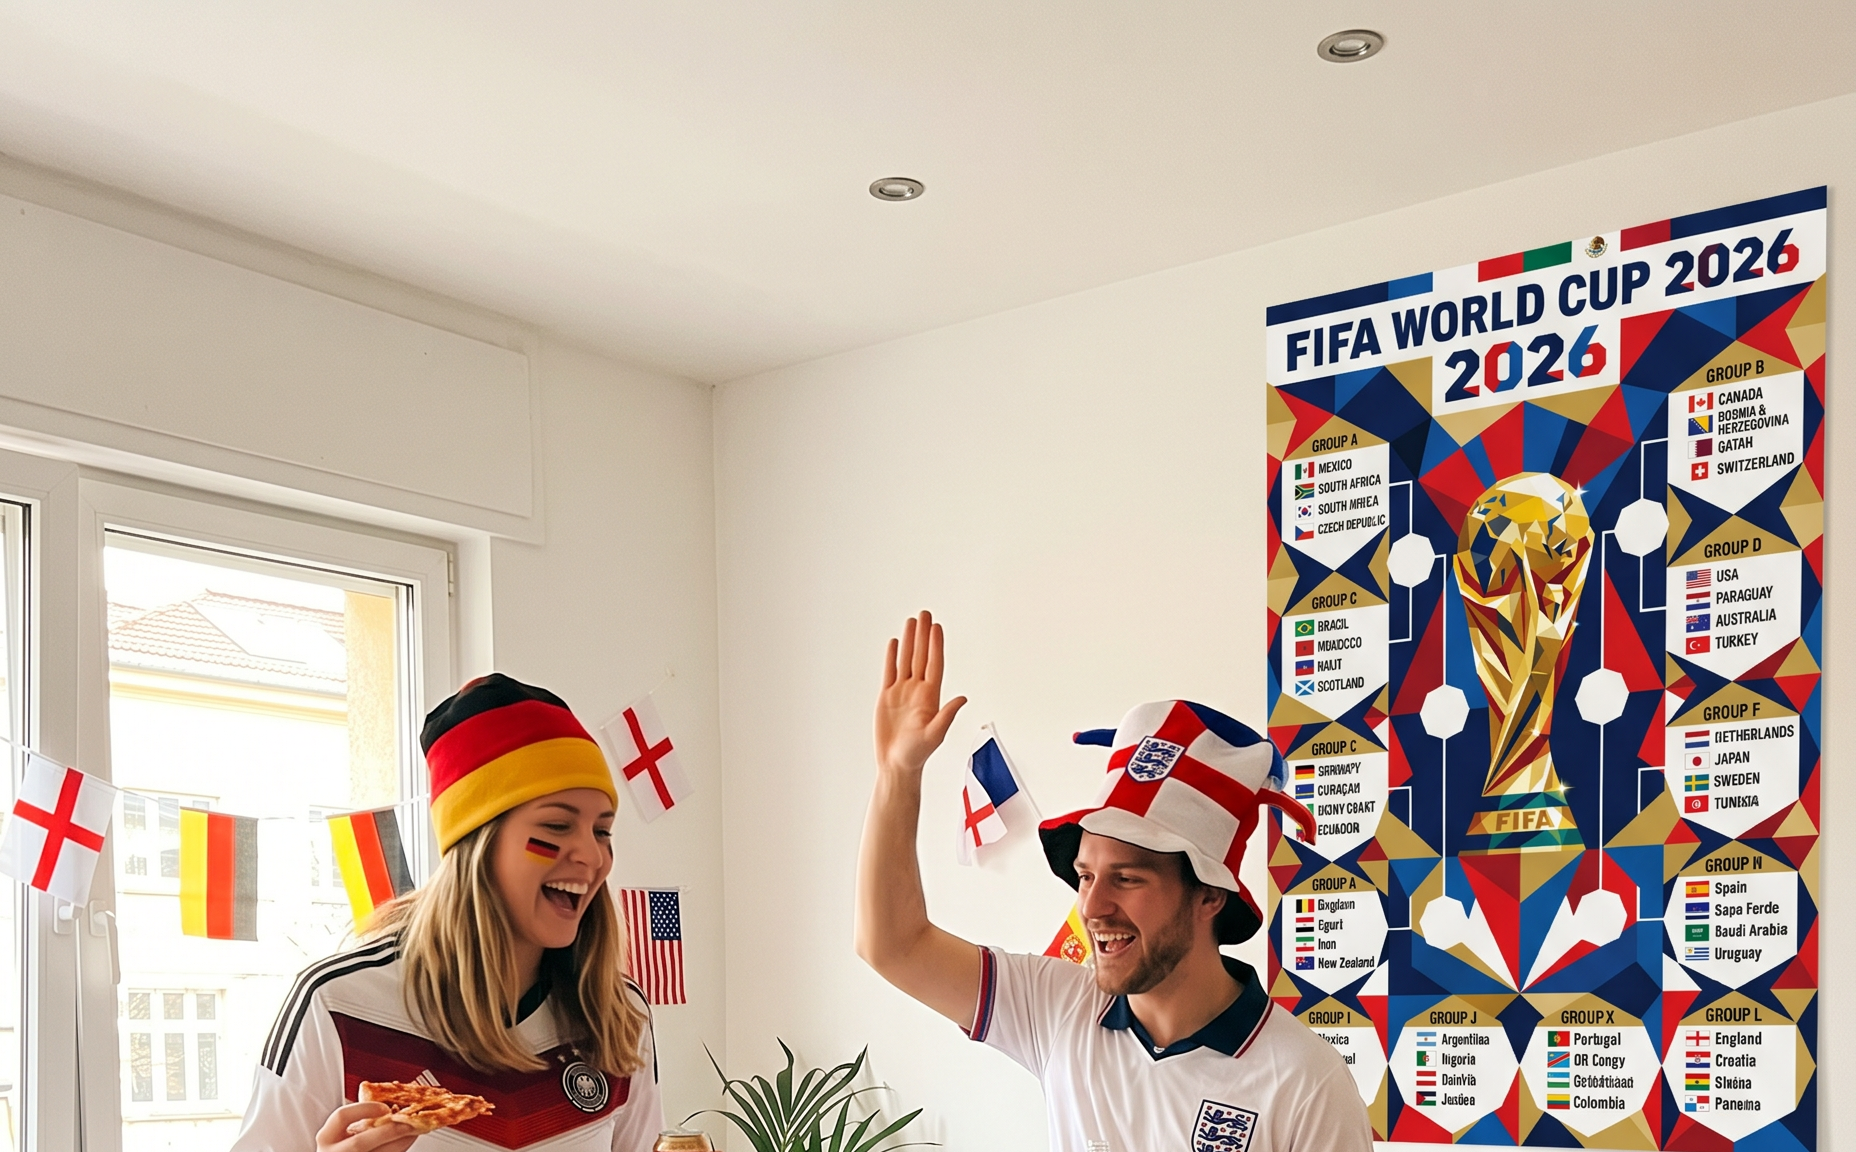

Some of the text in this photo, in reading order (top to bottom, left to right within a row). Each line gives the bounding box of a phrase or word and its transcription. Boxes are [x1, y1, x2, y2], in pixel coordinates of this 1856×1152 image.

[1286, 228, 1799, 372] FIFA WORLD CUP 2026
[1445, 324, 1606, 402] 2026
[1706, 360, 1764, 383] GROUP B
[1718, 387, 1763, 405] CANADA
[1759, 404, 1766, 416] &
[1718, 414, 1789, 435] HERZEGOVINA
[1312, 434, 1358, 452] GROUP A
[1718, 436, 1753, 453] GATAH
[1319, 459, 1352, 474] MEXICO
[1717, 452, 1794, 475] SWITZERLAND
[1318, 474, 1381, 494] SOUTH AFRICA
[1318, 500, 1347, 515] SOUTH
[1318, 521, 1344, 534] CZECH
[1704, 538, 1761, 558] GROUP D
[1717, 568, 1738, 582] USA
[1312, 592, 1357, 609] GROUP C
[1716, 586, 1773, 604] PARAGUAY
[1716, 608, 1776, 627] AUSTRALIA
[1715, 632, 1758, 649] TURKEY
[1318, 677, 1364, 692] SCOTLAND
[1704, 703, 1760, 721] GROUP F
[1312, 740, 1356, 755] GROUP C
[1715, 751, 1750, 765] JAPAN
[1714, 772, 1760, 787] SWEDEN
[1496, 810, 1554, 831] FIFA
[1706, 857, 1749, 872] GROUP
[1312, 877, 1356, 891] GROUP A
[1715, 881, 1746, 897] Spain
[1715, 902, 1779, 918] Sapa Ferde
[1749, 923, 1788, 936] Arabia
[1715, 948, 1762, 962] Uruguay
[1309, 1012, 1350, 1024] GROUP I
[1430, 1011, 1477, 1024] GROUP J
[1561, 1011, 1614, 1024] GROUP X
[1706, 1008, 1762, 1022] GROUP L
[1715, 1032, 1762, 1047] England
[1592, 1054, 1625, 1069] Congy
[1574, 1096, 1625, 1109] Colombia
